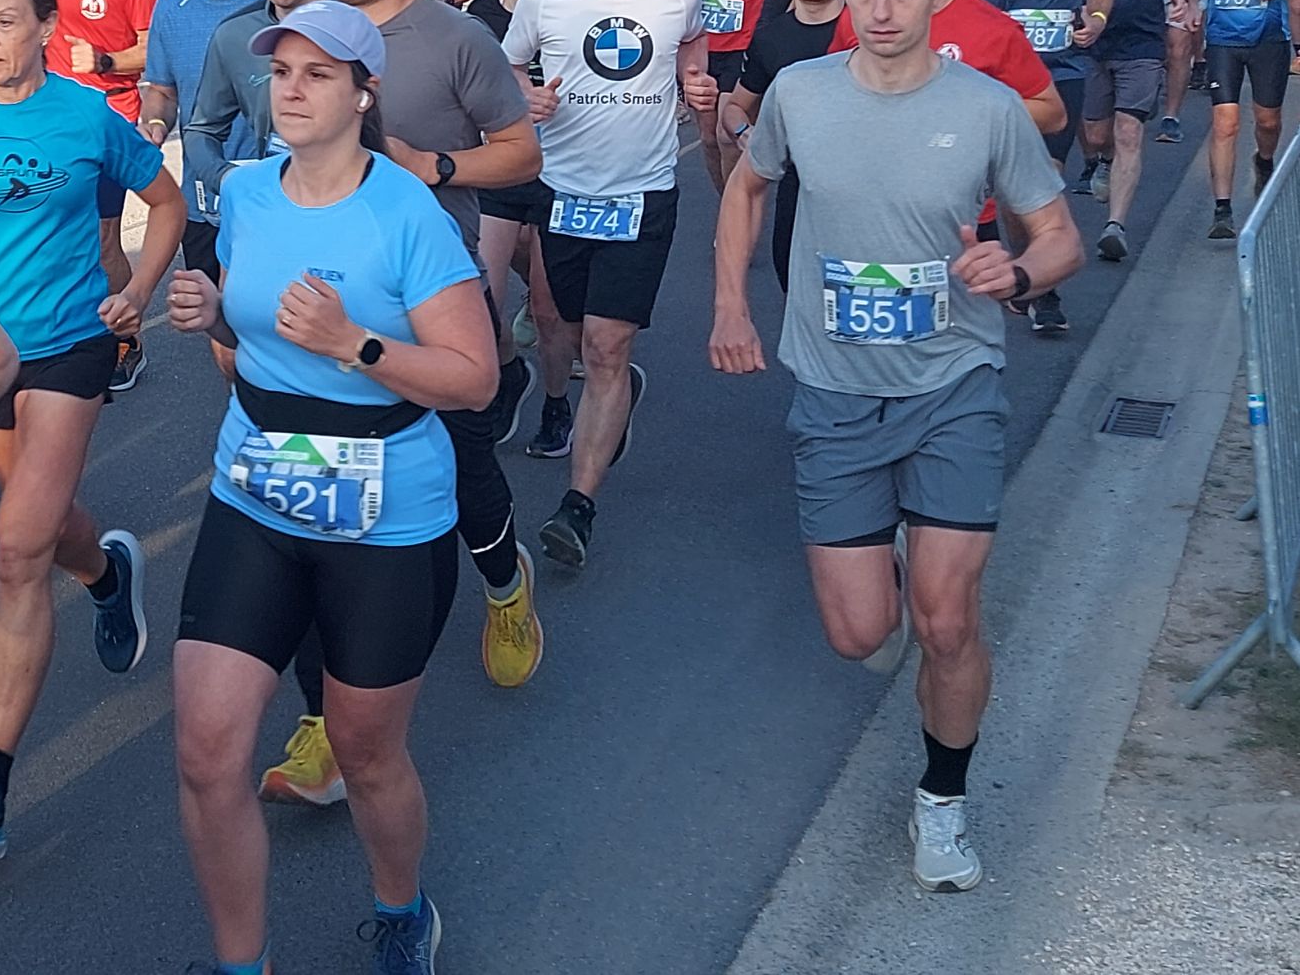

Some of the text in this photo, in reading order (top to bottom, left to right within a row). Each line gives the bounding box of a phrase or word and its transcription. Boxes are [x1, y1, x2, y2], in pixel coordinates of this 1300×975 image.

[588, 18, 649, 39] BMW
[701, 10, 730, 29] 747
[1024, 27, 1059, 46] 787
[568, 92, 663, 105] Patrick Smets
[571, 207, 620, 232] 574
[849, 298, 914, 334] 551
[263, 478, 339, 524] 521
